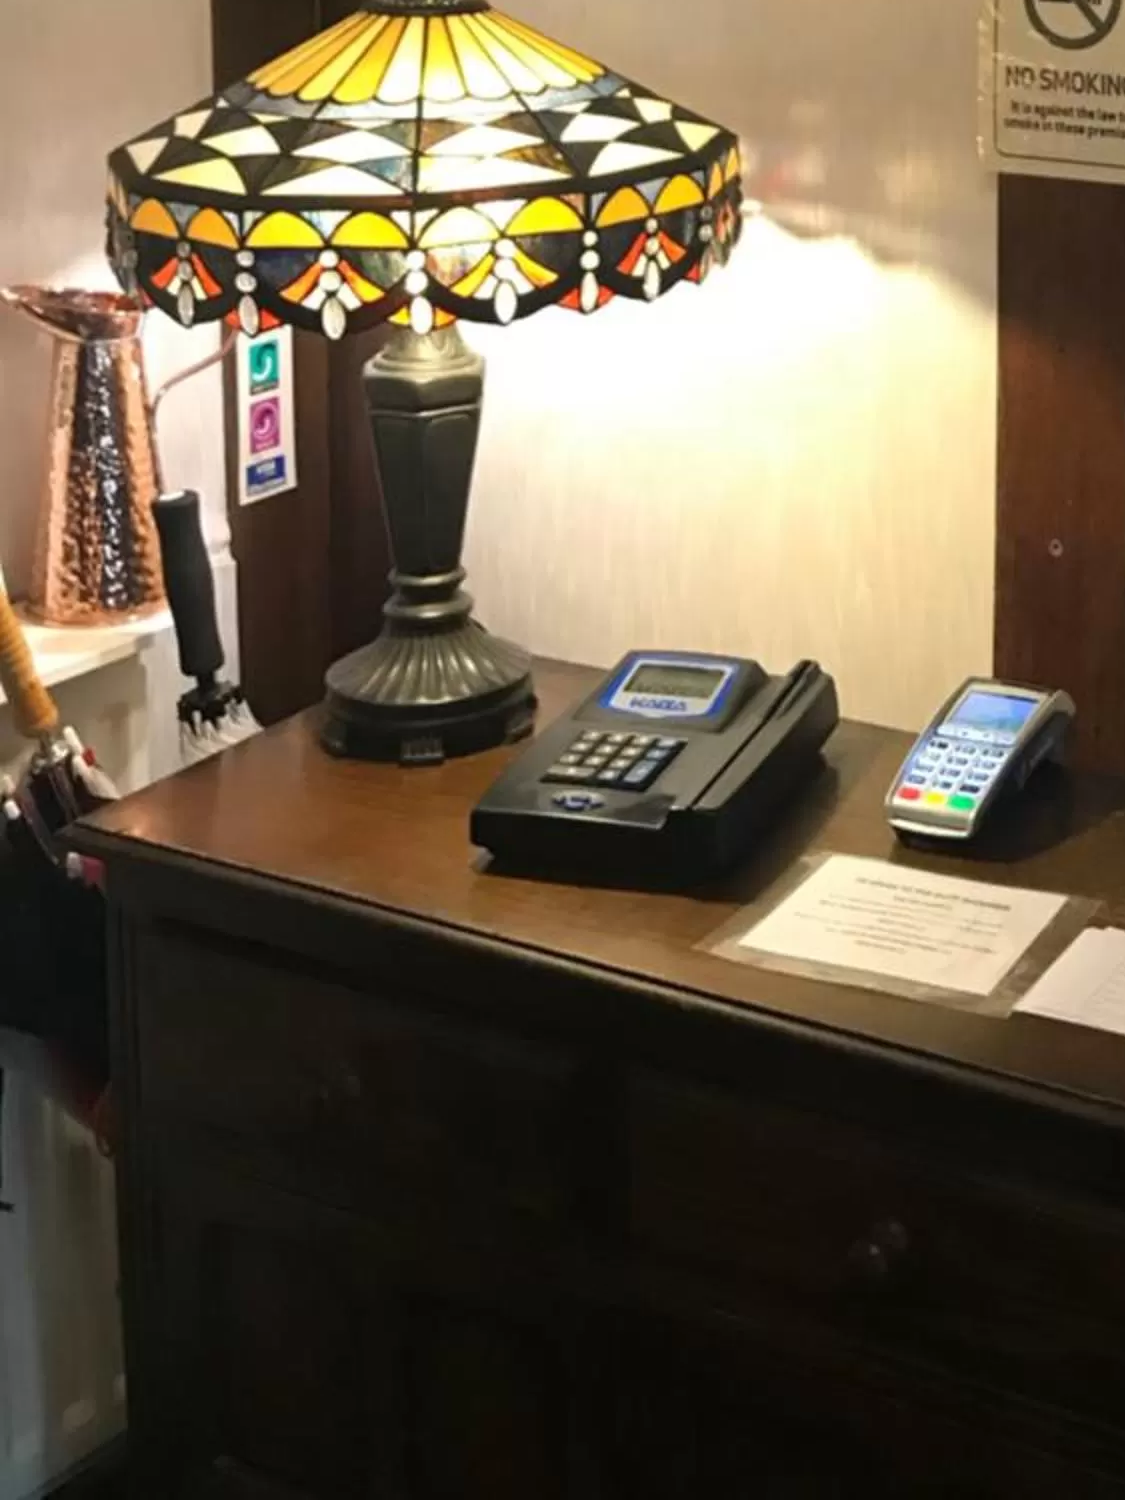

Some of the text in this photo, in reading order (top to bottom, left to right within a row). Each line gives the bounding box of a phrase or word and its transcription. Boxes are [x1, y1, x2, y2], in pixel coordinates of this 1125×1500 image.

[1005, 65, 1036, 90] NO
[1034, 104, 1073, 120] against
[1076, 105, 1095, 120] the
[1003, 117, 1040, 132] smoke
[1041, 120, 1053, 133] in
[1055, 120, 1085, 135] these
